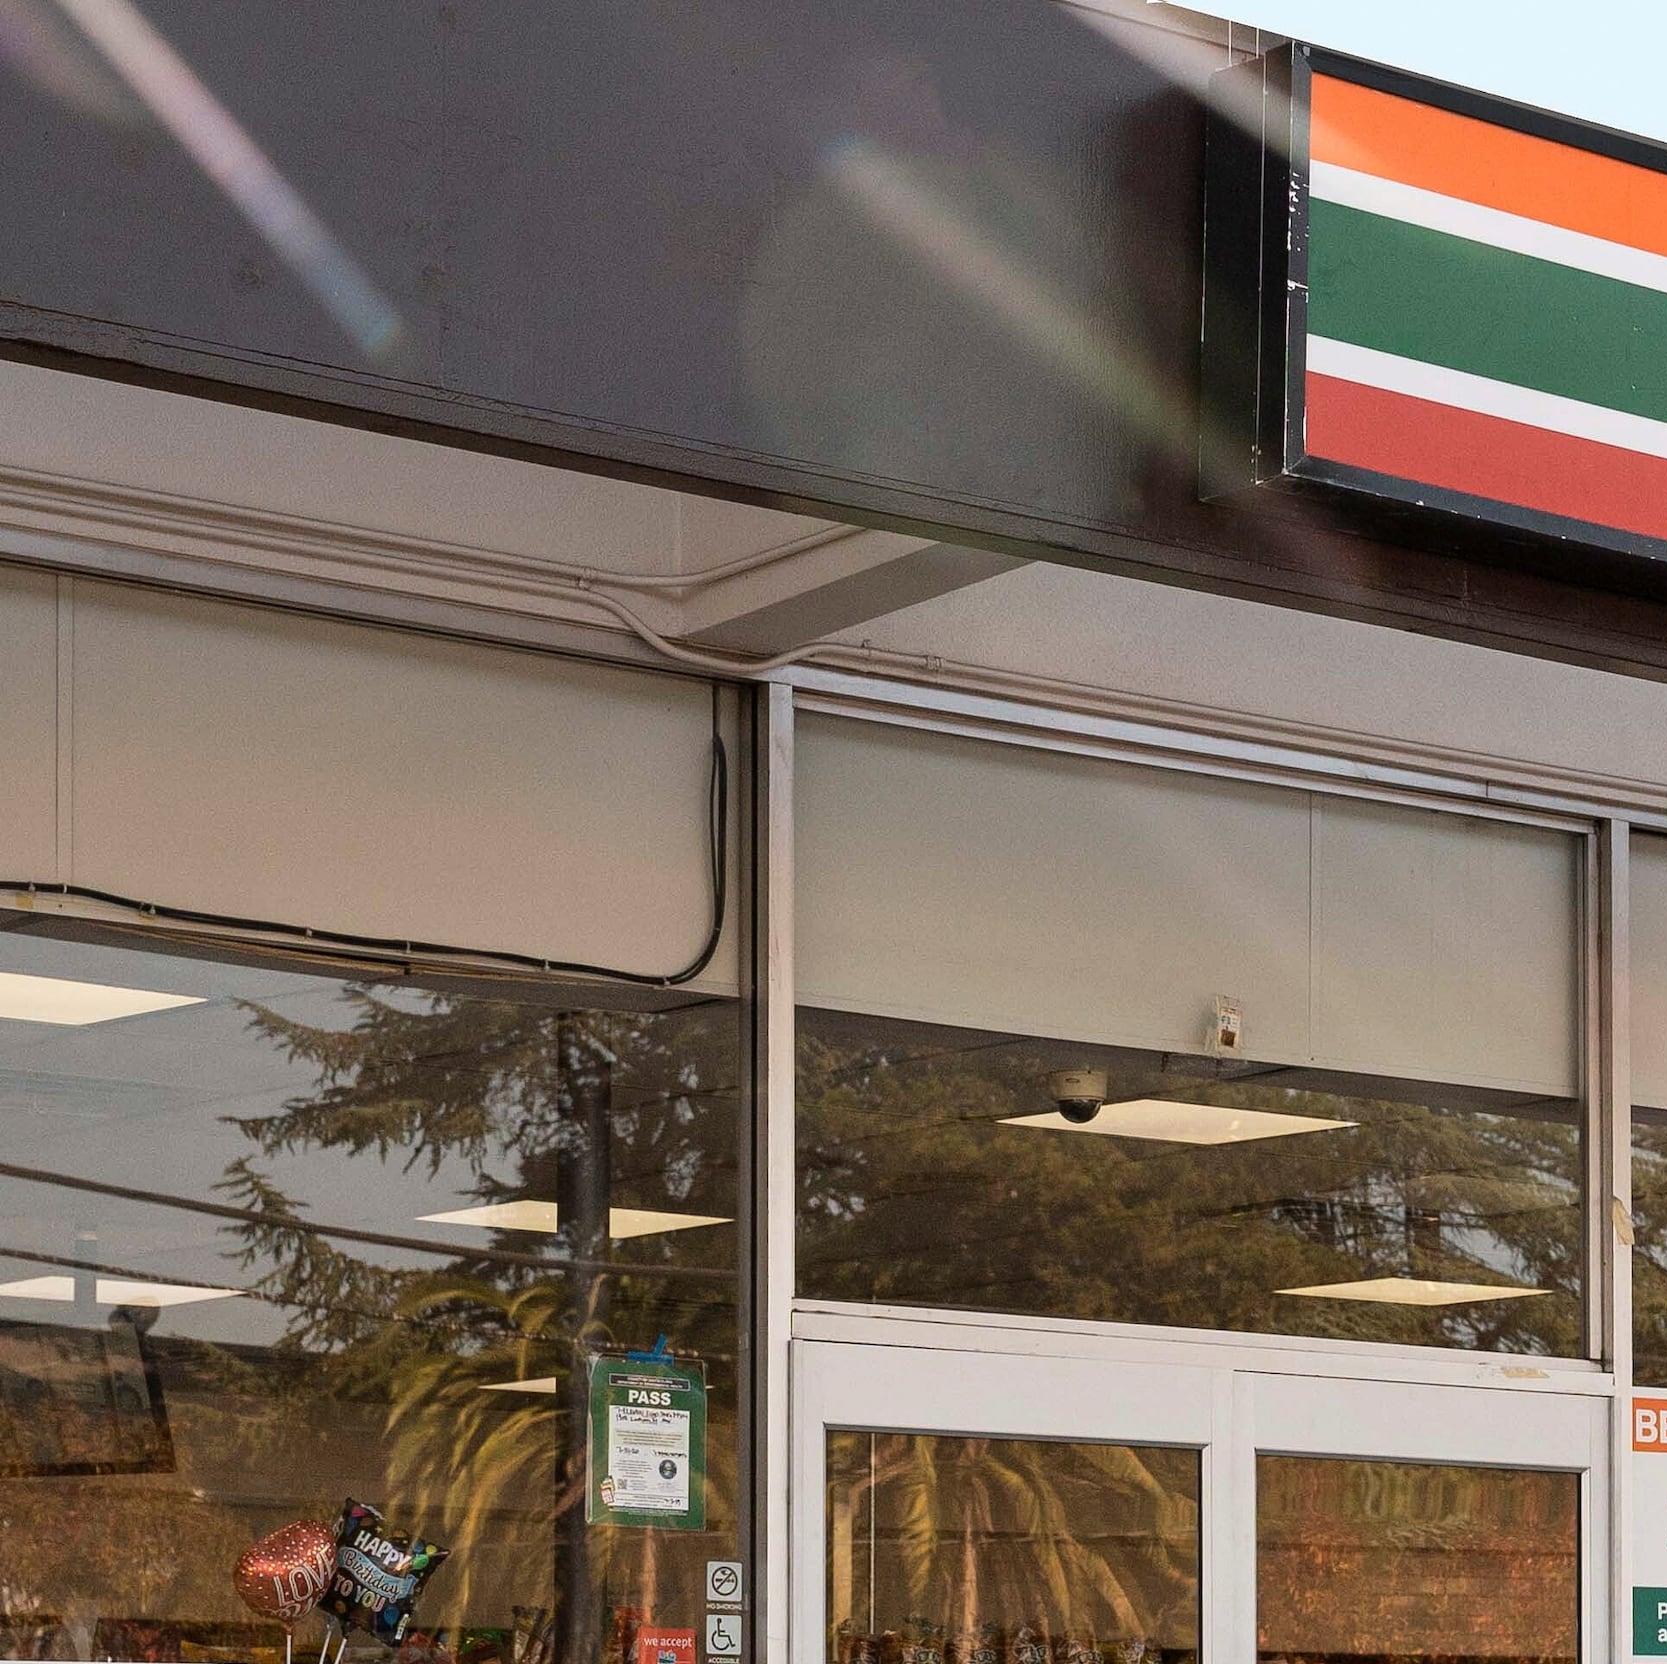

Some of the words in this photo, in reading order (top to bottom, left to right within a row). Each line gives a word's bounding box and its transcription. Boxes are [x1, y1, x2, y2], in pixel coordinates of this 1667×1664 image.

[628, 1390, 671, 1405] PASS
[354, 1530, 411, 1570] HAPPY
[273, 1543, 336, 1607] LOVE
[335, 1574, 353, 1596] TO
[355, 1585, 385, 1612] YOU
[343, 1550, 400, 1600] Birthday
[643, 1637, 658, 1647] we
[660, 1637, 692, 1650] accept
[1658, 1628, 1667, 1642] a
